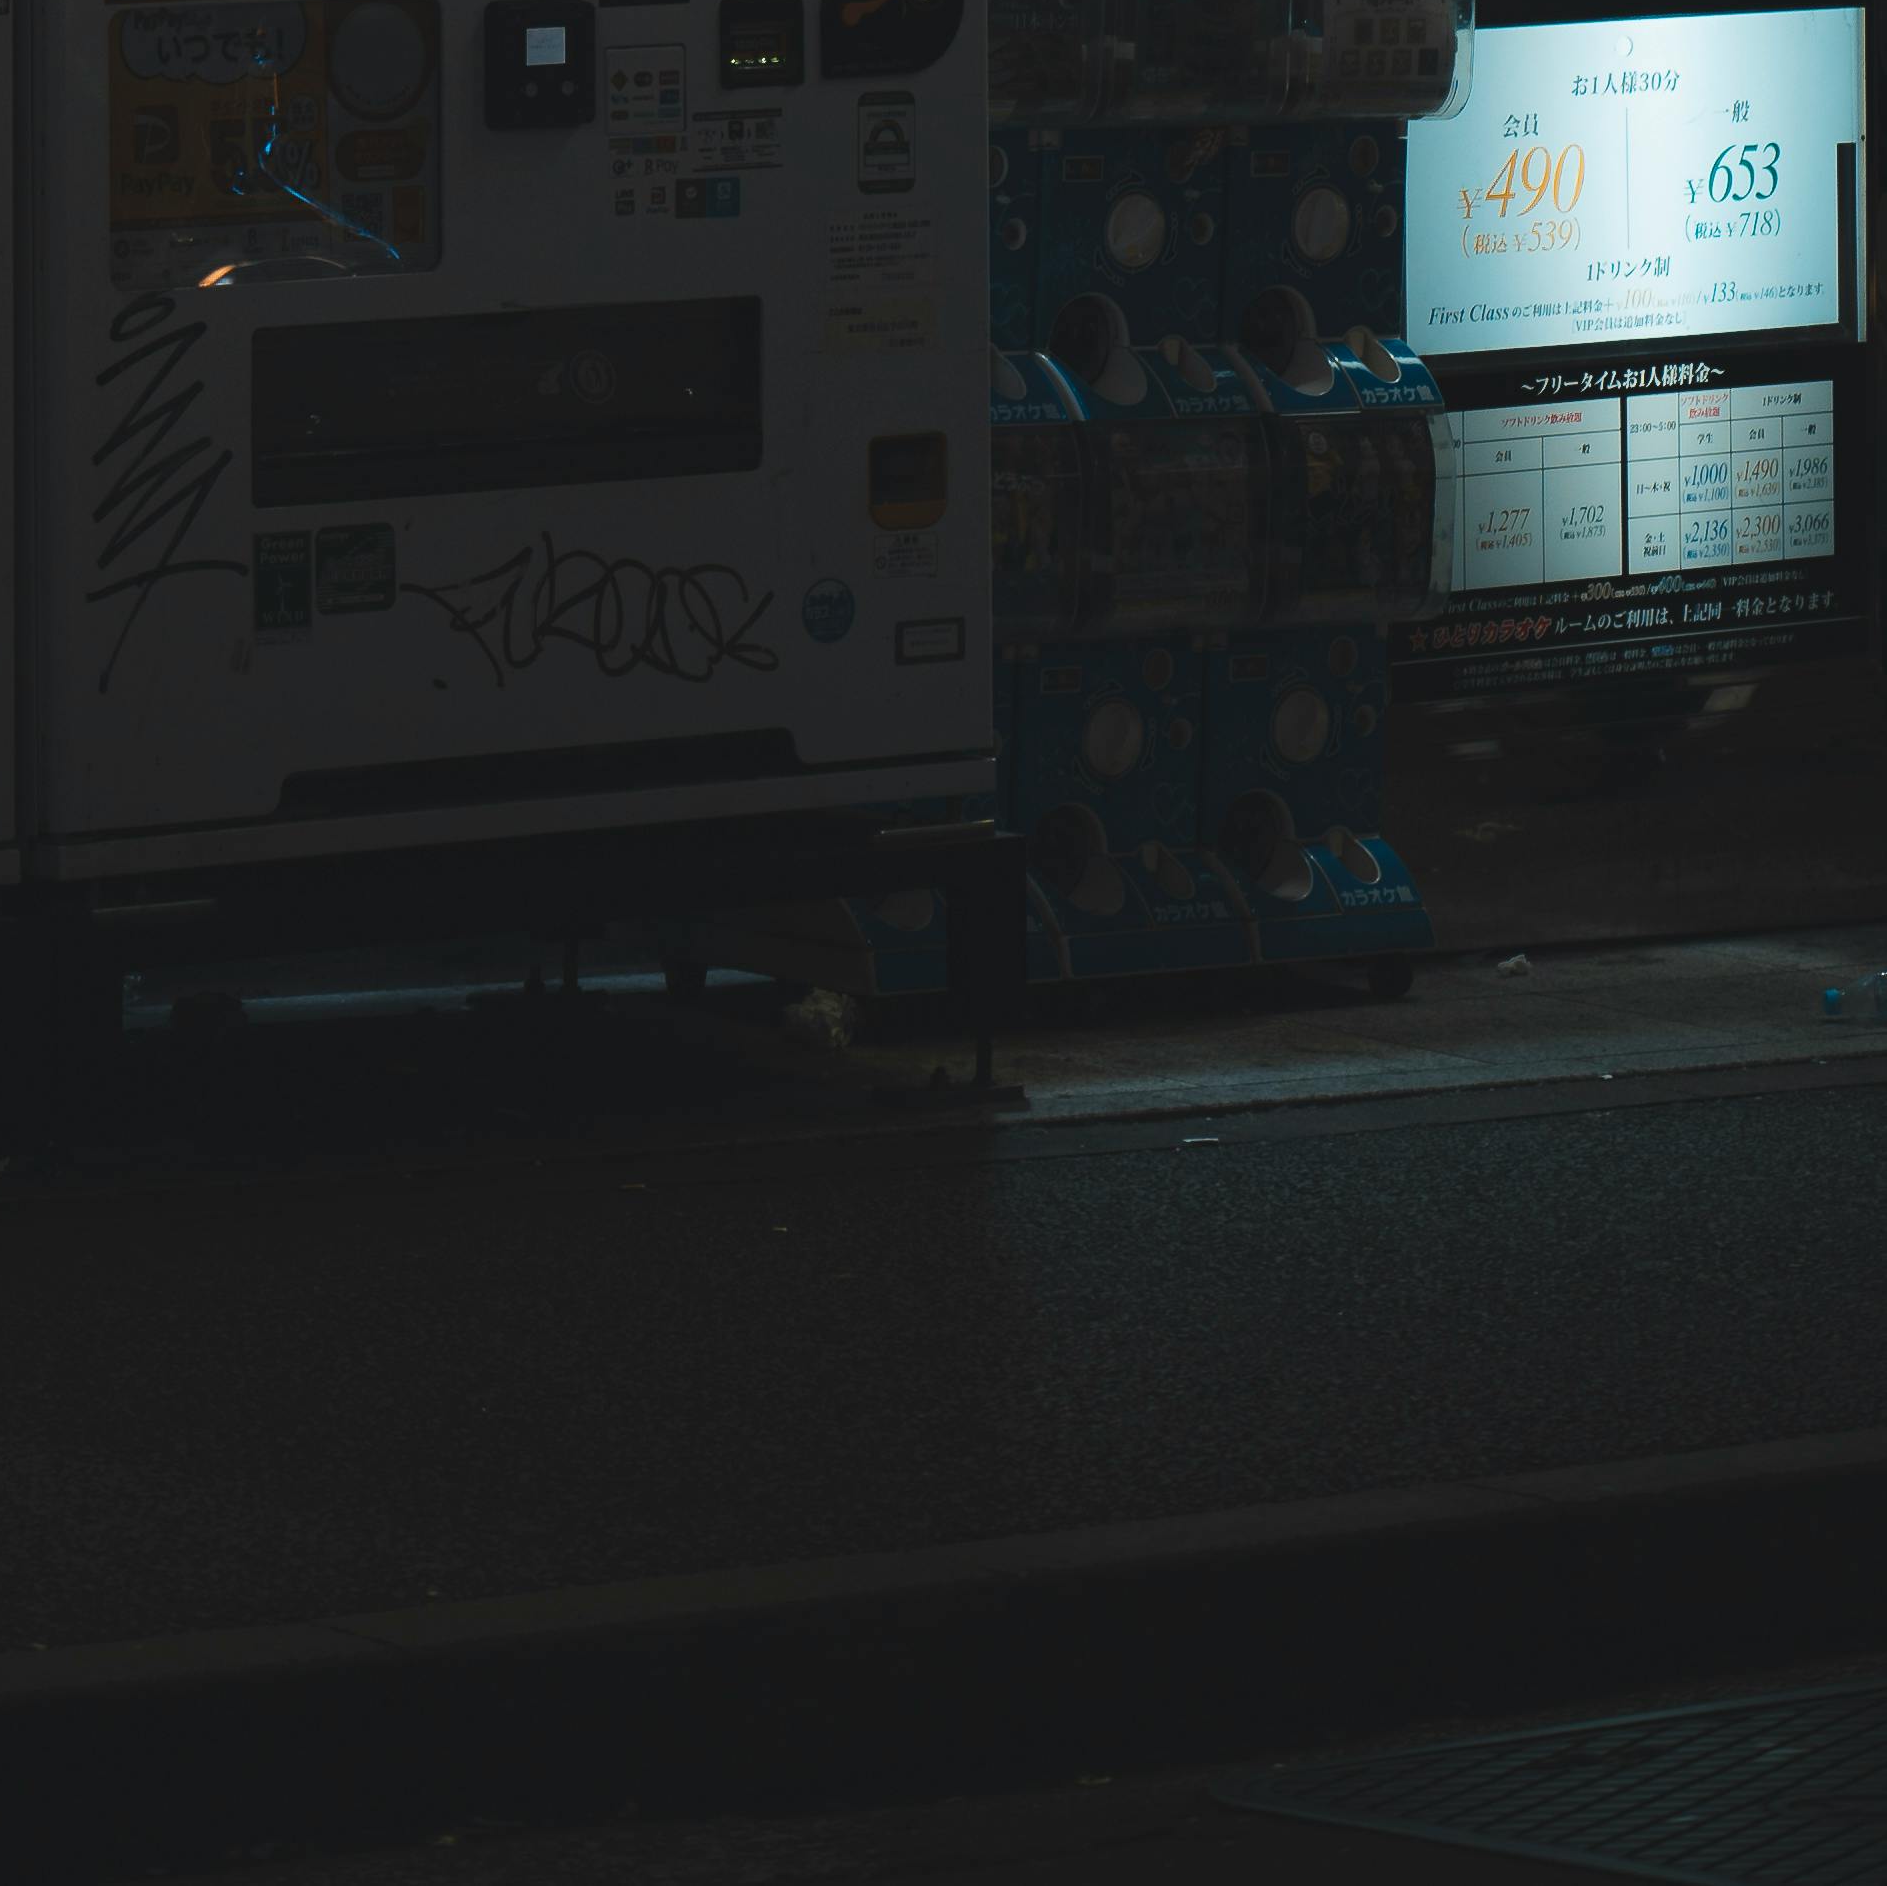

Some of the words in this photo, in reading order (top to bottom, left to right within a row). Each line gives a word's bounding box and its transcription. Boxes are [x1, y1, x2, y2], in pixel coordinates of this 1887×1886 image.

[156, 31, 286, 66] いつでも!
[1571, 70, 1681, 96] お1人様30分
[1716, 99, 1751, 124] 一般
[1502, 113, 1540, 139] 会員
[120, 172, 196, 197] PayPay
[1457, 144, 1586, 220] ¥490
[1684, 141, 1782, 205] ¥653
[1586, 255, 1671, 284] 1ドリンク制
[1428, 306, 1466, 326] First
[1469, 303, 1511, 323] Class
[1175, 395, 1252, 414] カラオケ館
[1361, 386, 1434, 405] カラオケ館
[1683, 462, 1728, 486] ¥1,000
[1735, 458, 1780, 482] ¥1,490
[1788, 456, 1829, 477] ¥1,986
[1477, 507, 1531, 535] ¥1,277
[1561, 505, 1605, 528] ¥1,702
[1735, 514, 1782, 539] ¥2,300
[1788, 513, 1830, 535] ¥3,066
[259, 537, 305, 549] Green
[1683, 519, 1729, 544] ¥2,136
[259, 551, 306, 564] Power
